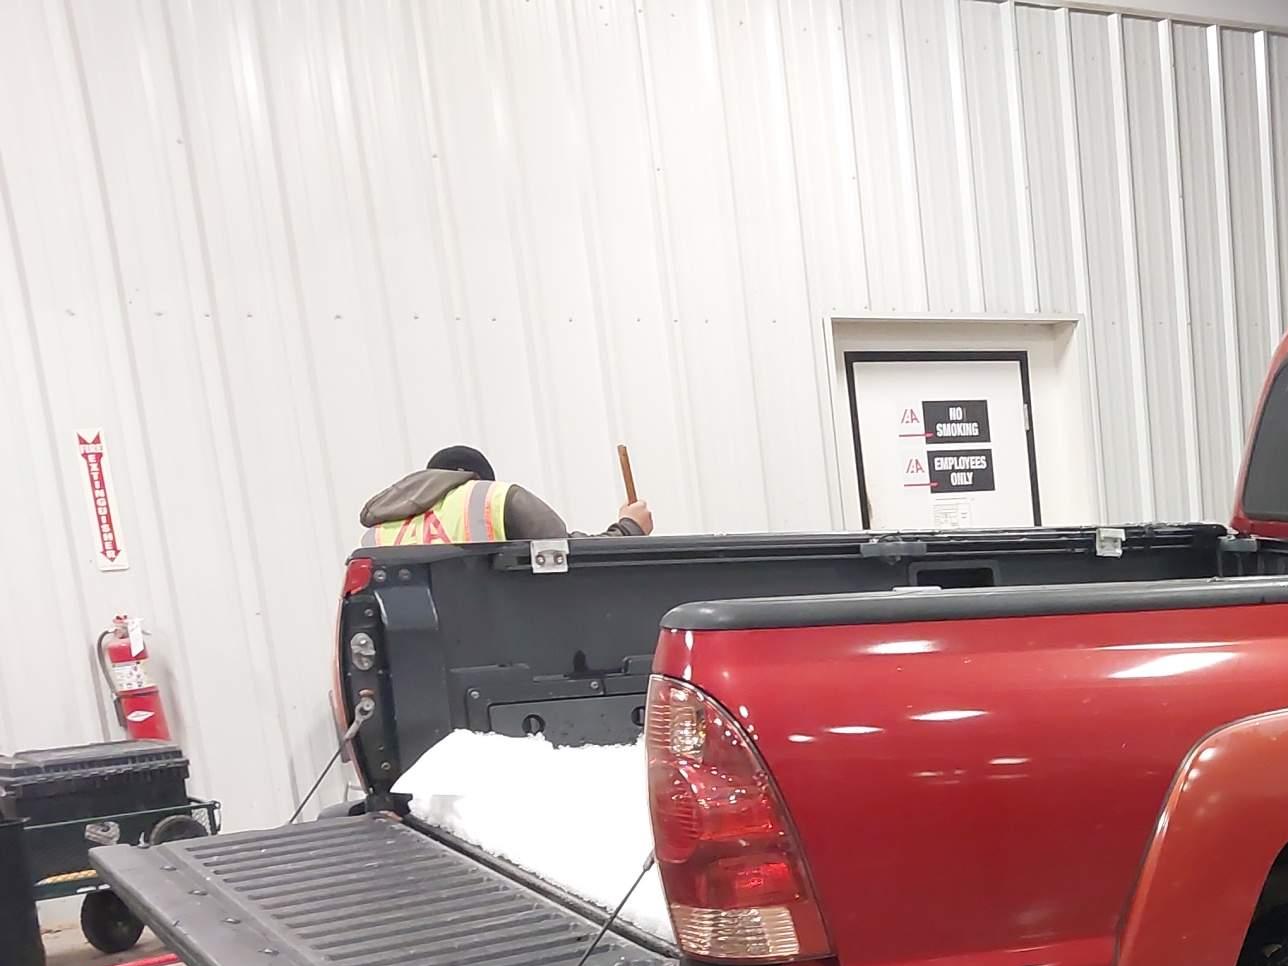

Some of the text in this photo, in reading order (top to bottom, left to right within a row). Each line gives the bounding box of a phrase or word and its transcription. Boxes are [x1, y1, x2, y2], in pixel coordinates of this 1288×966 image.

[949, 406, 963, 421] NO
[936, 422, 979, 437] SMOKING
[934, 455, 987, 471] EMPLOYEES
[950, 472, 974, 486] ONLY
